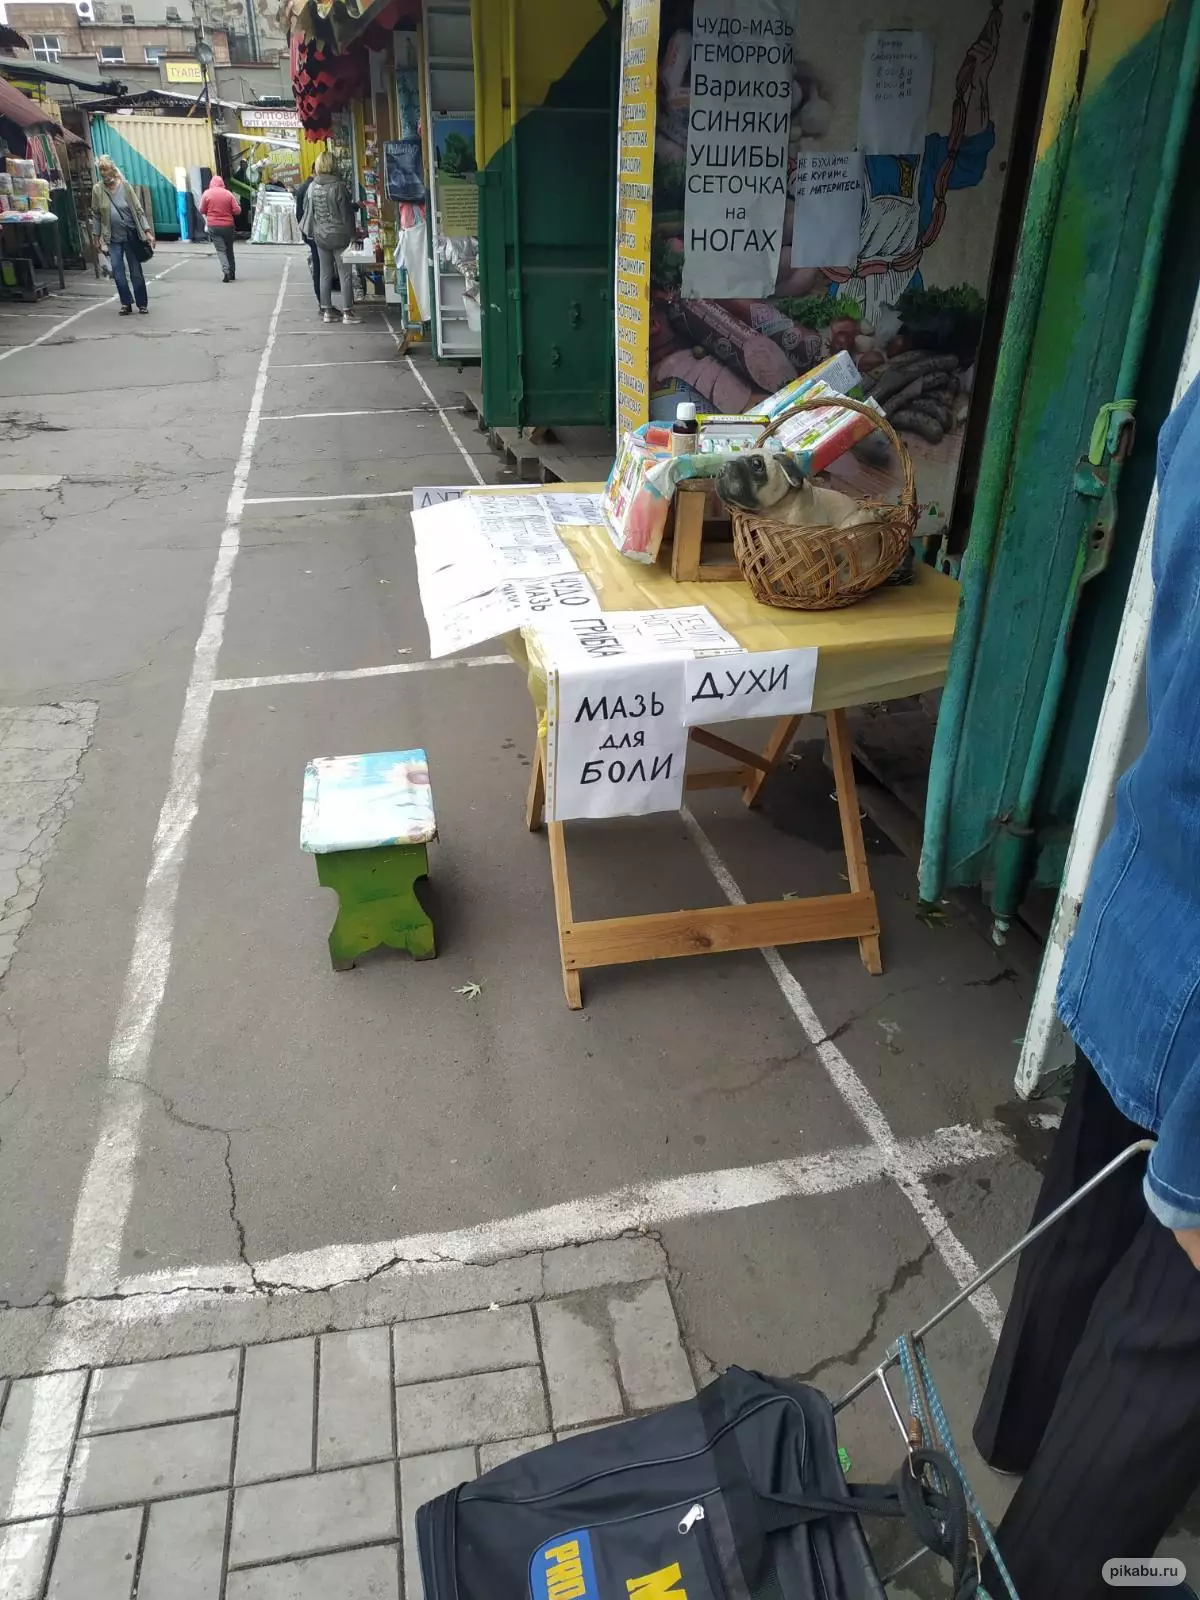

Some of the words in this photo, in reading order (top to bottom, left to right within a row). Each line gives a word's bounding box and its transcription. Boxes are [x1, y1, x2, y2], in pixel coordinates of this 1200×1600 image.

[696, 17, 794, 37] ЧУДО-МАЗЬ
[693, 42, 794, 64] ГЕМОРРОЙ
[170, 67, 201, 78] ТУАЛЕ
[694, 75, 791, 100] Варикоз
[691, 110, 789, 133] СИНЯКИ
[690, 145, 785, 169] УШИБЫ
[798, 158, 807, 169] НЕ
[688, 175, 786, 195] СЕТОЧКА
[797, 173, 808, 182] НЕ
[797, 187, 806, 196] НЕ
[809, 180, 861, 195] МАТЕРИТЕСЬ
[725, 206, 747, 220] на
[691, 229, 777, 252] НОГАХ
[525, 578, 553, 611] МАЗЬ
[550, 577, 591, 606] ЧУДО
[570, 617, 626, 658] ГРИБКА
[612, 623, 643, 638] ОТ
[675, 613, 728, 648] ЛЕЧИТ
[691, 664, 790, 702] ДУХИ
[574, 691, 665, 723] МАЗЬ
[580, 753, 674, 785] БОЛИ
